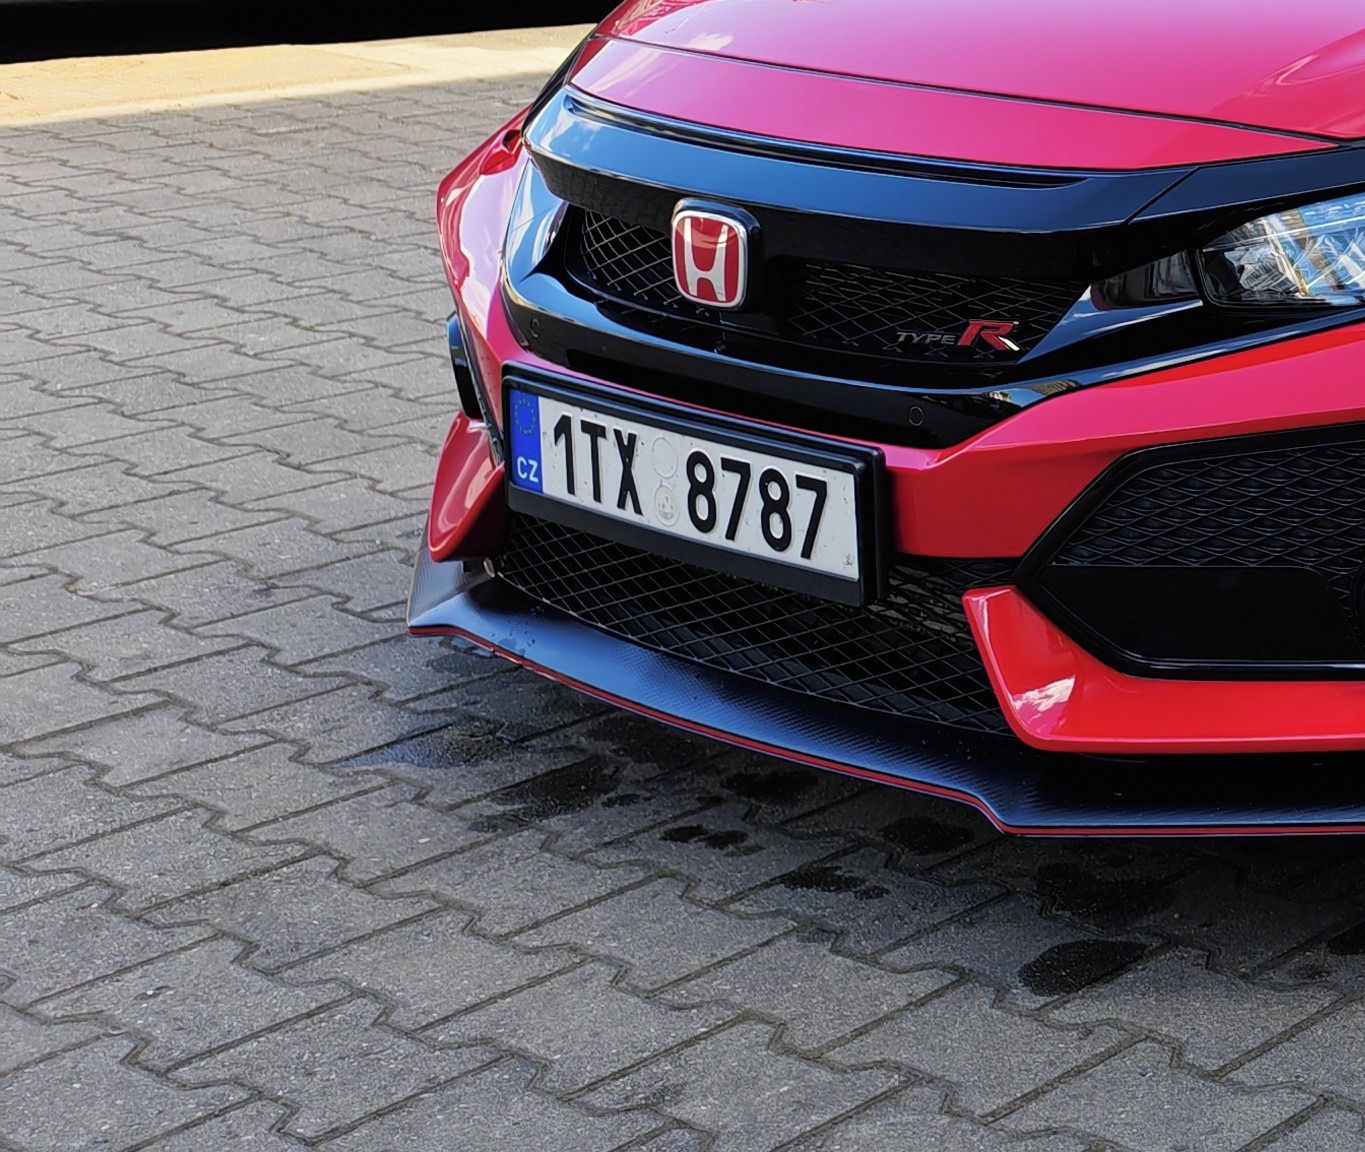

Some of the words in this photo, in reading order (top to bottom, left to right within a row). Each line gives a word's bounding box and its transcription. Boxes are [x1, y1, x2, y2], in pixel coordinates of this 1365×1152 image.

[896, 331, 957, 345] TYPE
[957, 318, 1020, 351] R
[516, 455, 540, 484] CZ
[553, 413, 644, 516] 1TX
[686, 449, 829, 560] 8787
